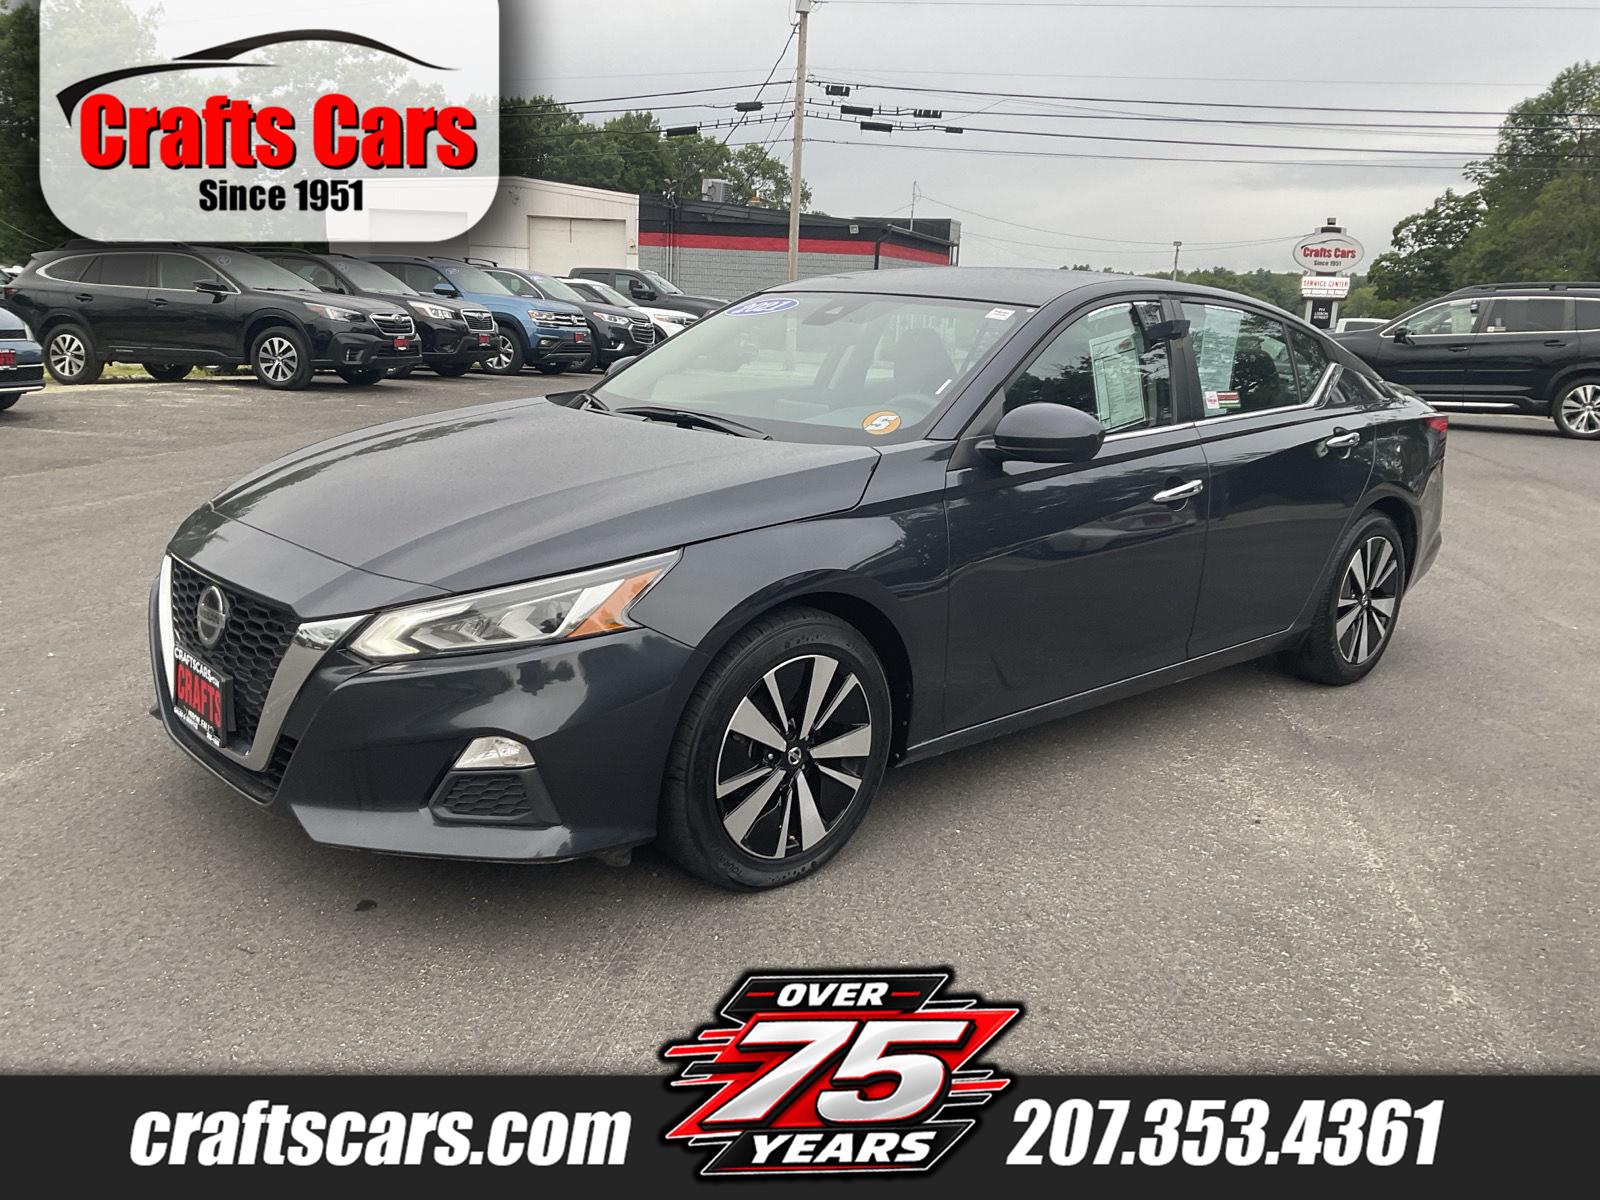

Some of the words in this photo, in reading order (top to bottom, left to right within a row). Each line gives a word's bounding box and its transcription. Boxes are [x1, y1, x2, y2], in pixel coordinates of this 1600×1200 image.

[1303, 247, 1333, 258] Crafts
[1334, 248, 1357, 259] Cars
[1303, 279, 1326, 288] SERVICE
[1328, 280, 1349, 288] CENTER
[175, 662, 222, 728] CRAFTS
